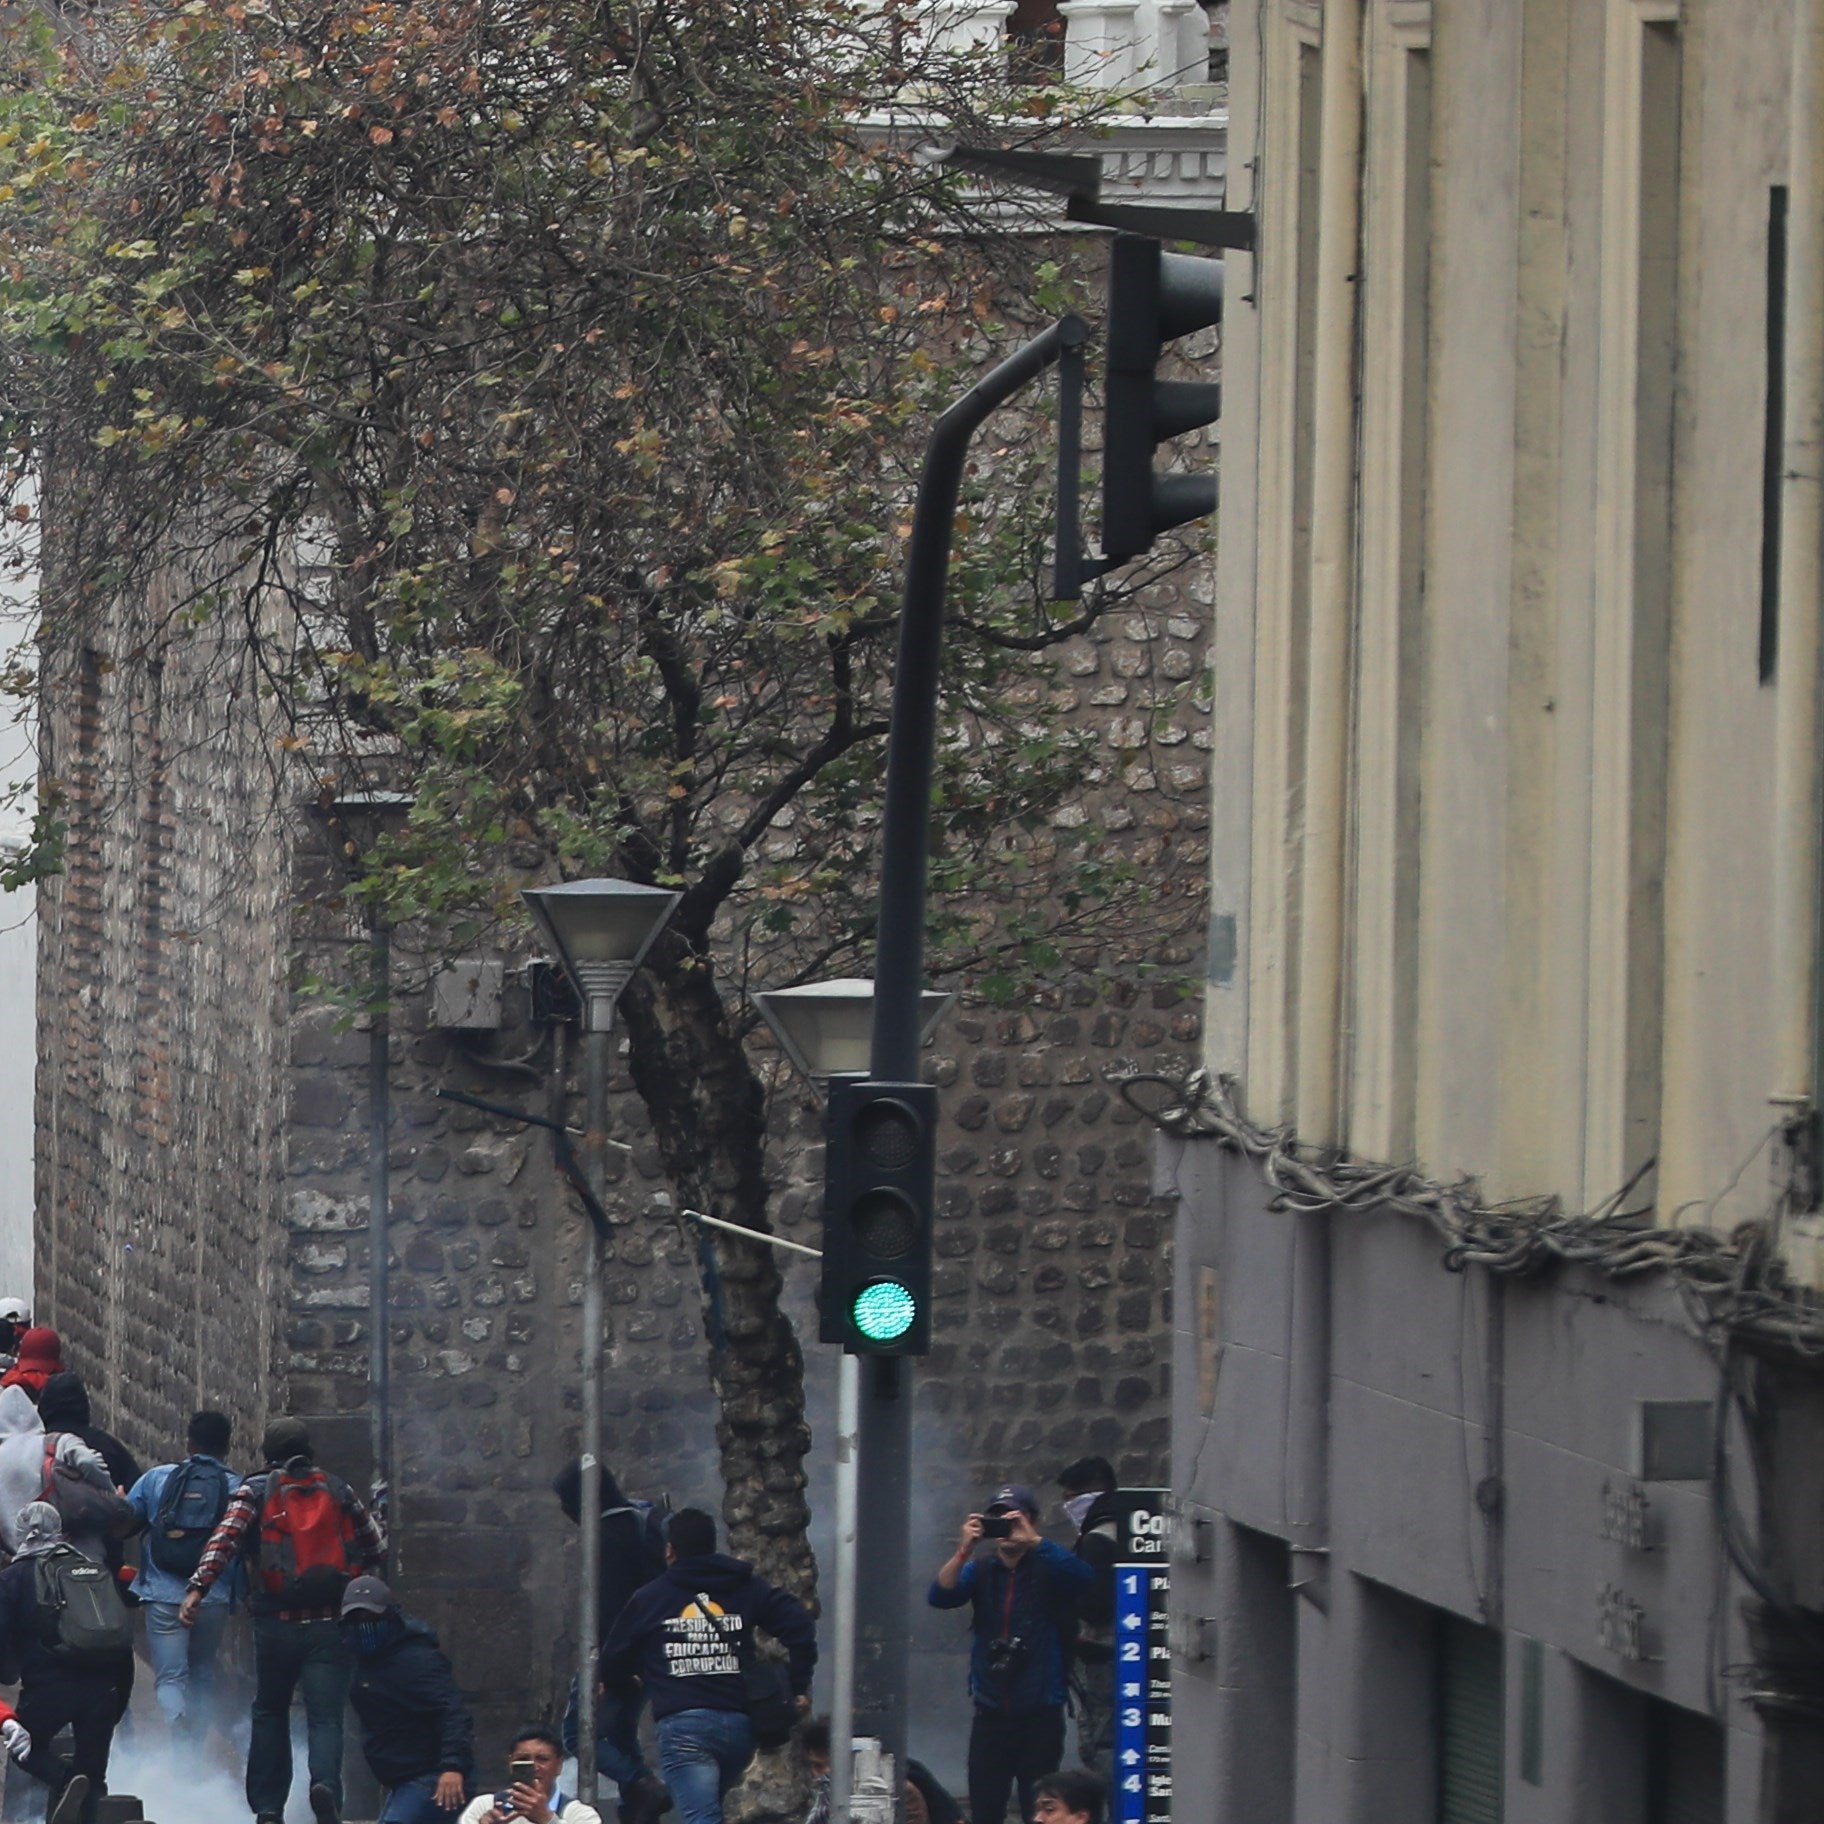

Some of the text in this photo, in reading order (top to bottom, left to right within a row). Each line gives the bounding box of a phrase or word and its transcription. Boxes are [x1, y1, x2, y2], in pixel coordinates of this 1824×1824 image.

[1121, 1574, 1138, 1595] 1
[1119, 1641, 1141, 1661] 2
[670, 1653, 740, 1676] CORRUPCIÓN
[1121, 1707, 1142, 1727] 3
[1121, 1774, 1142, 1793] 4
